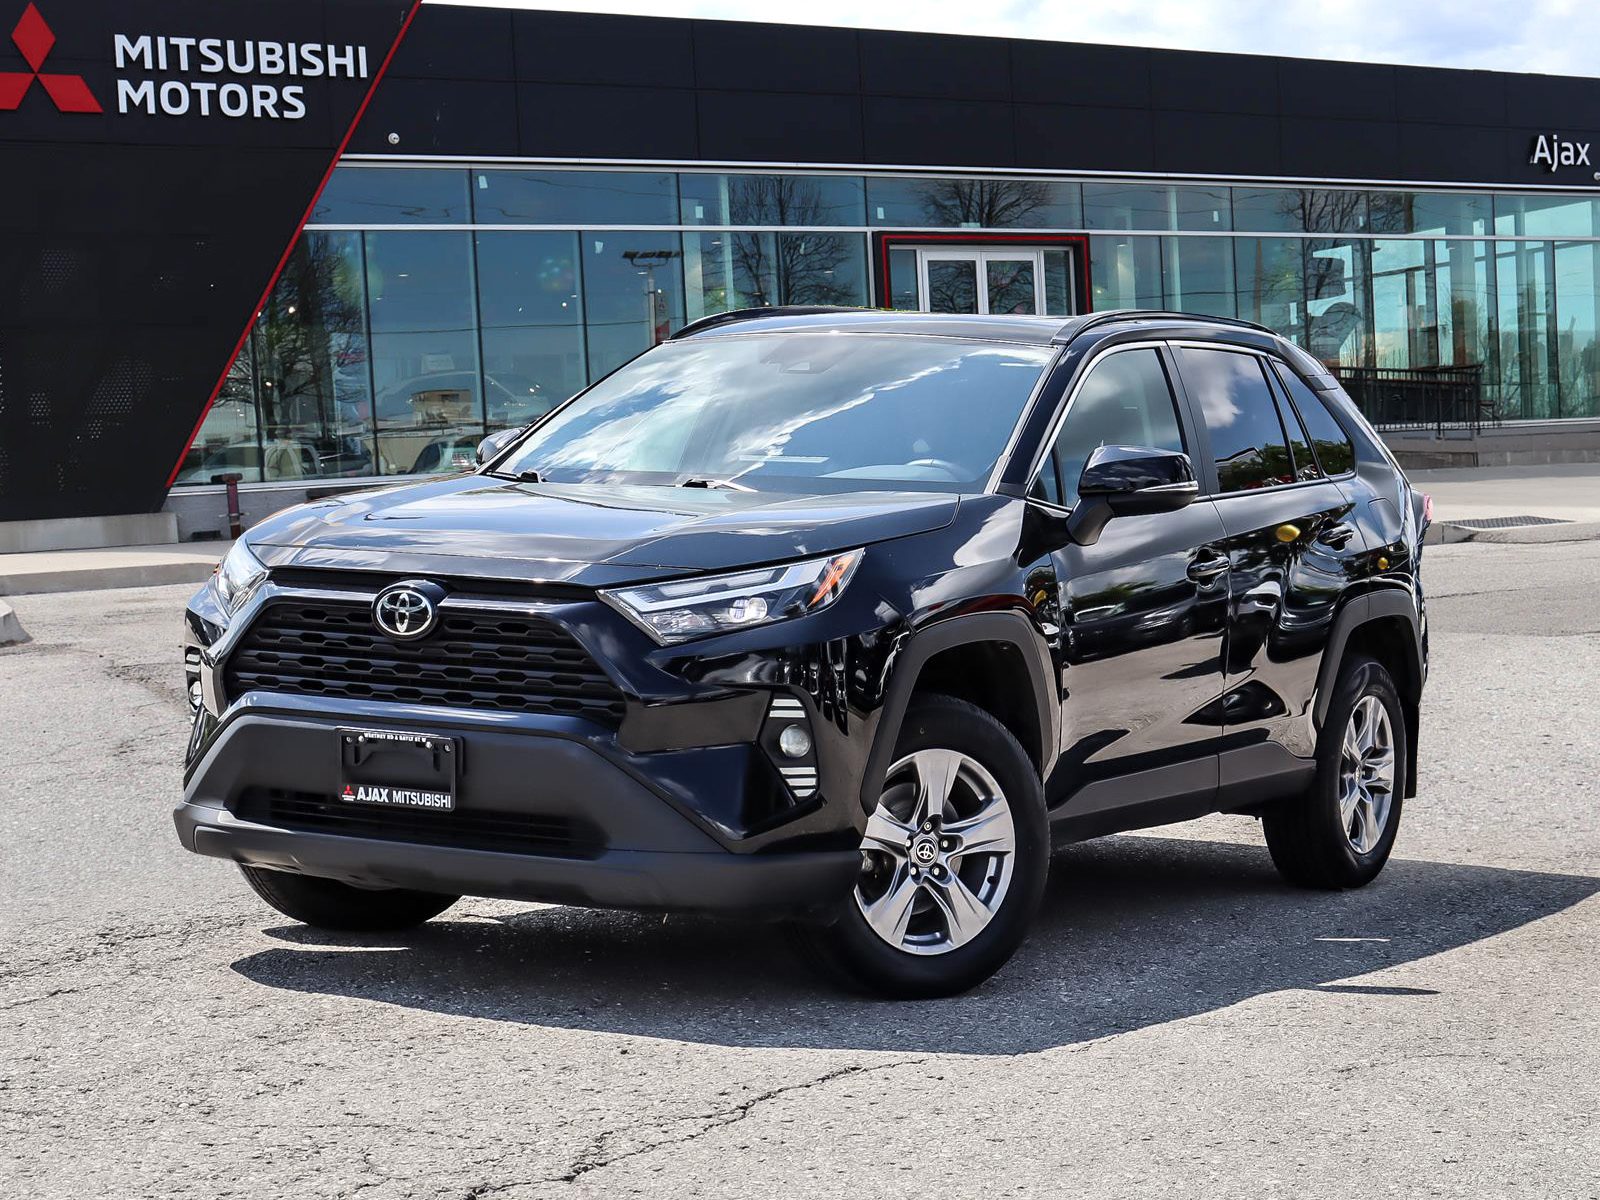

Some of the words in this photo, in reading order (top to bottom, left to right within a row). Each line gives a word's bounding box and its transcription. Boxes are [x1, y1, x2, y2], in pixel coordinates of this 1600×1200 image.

[114, 34, 368, 78] MITSUBISHI
[117, 79, 306, 119] MOTORS
[1533, 134, 1591, 172] Ajax
[357, 786, 389, 803] AJAX
[392, 790, 451, 808] MITSUBISHI
